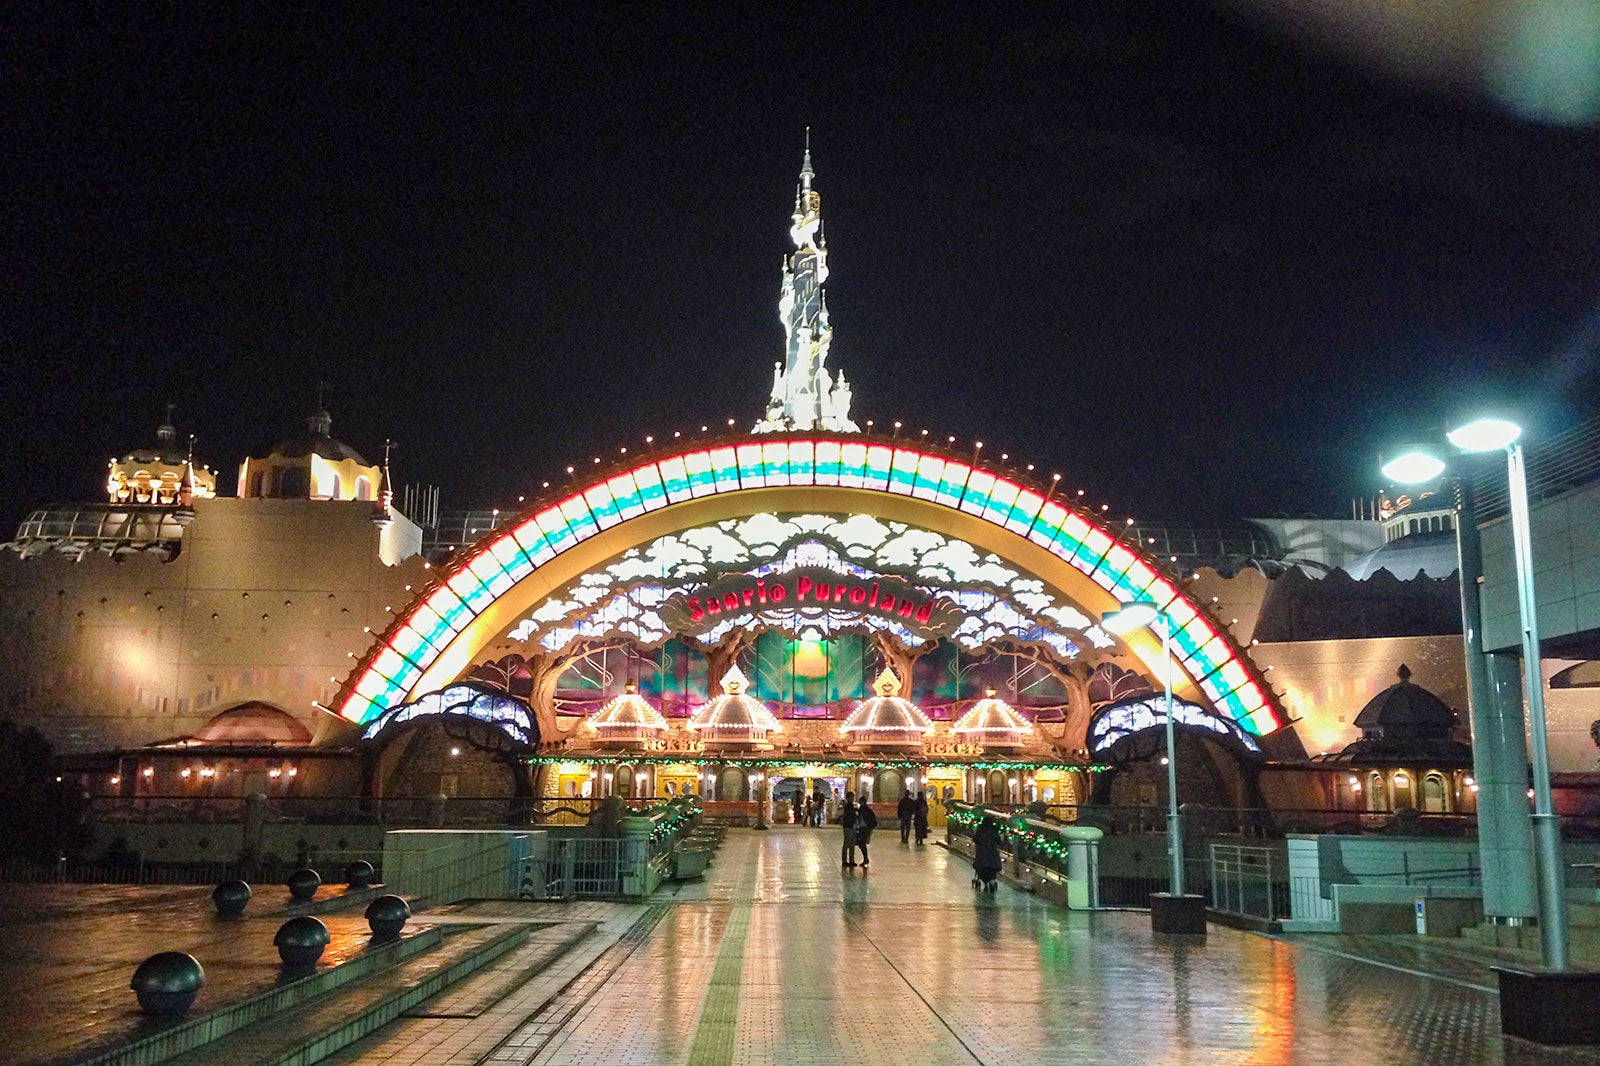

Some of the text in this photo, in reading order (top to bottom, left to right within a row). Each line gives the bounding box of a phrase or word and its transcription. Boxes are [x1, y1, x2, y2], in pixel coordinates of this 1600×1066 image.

[687, 576, 936, 625] Sanrio Puroland
[643, 739, 706, 751] TICKETS
[922, 742, 985, 755] TICKETS
